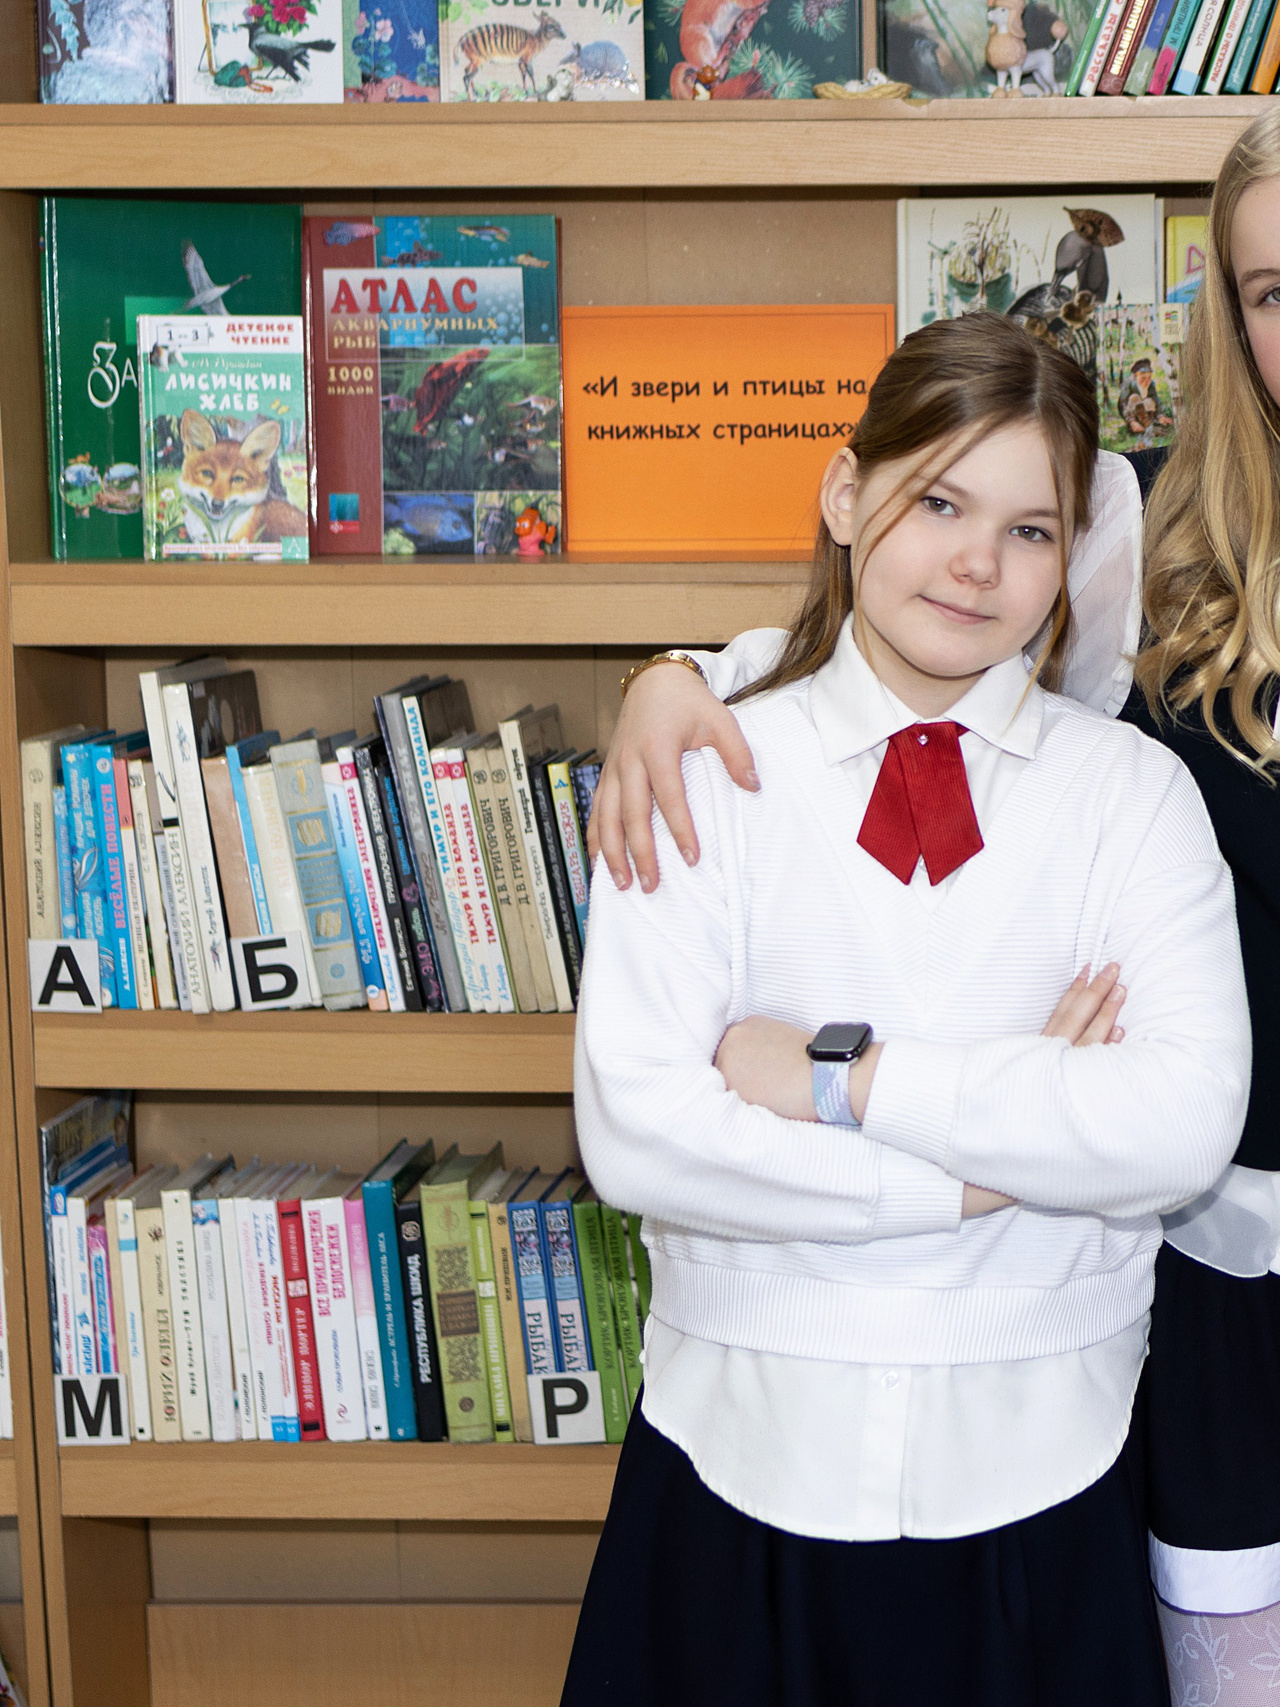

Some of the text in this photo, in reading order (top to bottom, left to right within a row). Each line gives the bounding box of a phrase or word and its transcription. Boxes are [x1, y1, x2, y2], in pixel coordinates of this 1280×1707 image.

[1209, 39, 1230, 82] РАССКАЗЫ
[331, 277, 478, 314] АТЛАС
[226, 322, 295, 333] ДЕТСКОЕ
[231, 335, 290, 345] ЧТЕНИЕ
[333, 317, 499, 332] АКВАРИУМНЫХ
[333, 336, 376, 349] РЫБ
[165, 372, 292, 391] ЛИСИЧКИН
[328, 366, 374, 382] 1000
[583, 376, 866, 403] «И звери и птицы на
[199, 393, 260, 411] ХЛЕБ
[588, 422, 700, 440] книжных
[404, 706, 431, 776] КОМАНДА
[422, 780, 436, 805] ЕГО
[517, 786, 535, 833] Говорящий
[429, 809, 438, 819] И
[100, 783, 125, 929] ВЕСЁЛЫЕ ПОВЕСТИ
[431, 823, 451, 873] ТИМУР
[479, 798, 505, 880] ГРИГОРОВИЧ
[498, 796, 524, 879] ГРИГОРОВИЧ
[346, 786, 386, 948] ПРИКЛЮЧЕНИЯ ЭЛЕКТРОНИКА
[360, 765, 415, 991] Евгений Велтистов ПРИКЛЮЧЕНИЯ ЭЛЕКТРОНИКА
[456, 866, 468, 886] ЕГО
[473, 866, 484, 886] ЕГО
[167, 832, 202, 996] АНАТОЛИЙ АЛЕКСИН
[461, 890, 470, 898] И
[478, 890, 487, 898] И
[463, 903, 479, 943] ТИМУР
[480, 902, 496, 943] ТИМУР
[38, 945, 96, 1007] А
[242, 938, 299, 1003] Б
[321, 1223, 349, 1299] БЕЛОСНЕЖКИ
[405, 1253, 434, 1383] РЕСПУБЛИКА ШКИД
[294, 1306, 315, 1411] ЭЛИНОР ПОРТЕР
[481, 1304, 507, 1416] МИХАИЛ ПРИШВИН
[61, 1378, 123, 1438] М
[542, 1377, 589, 1438] Р
